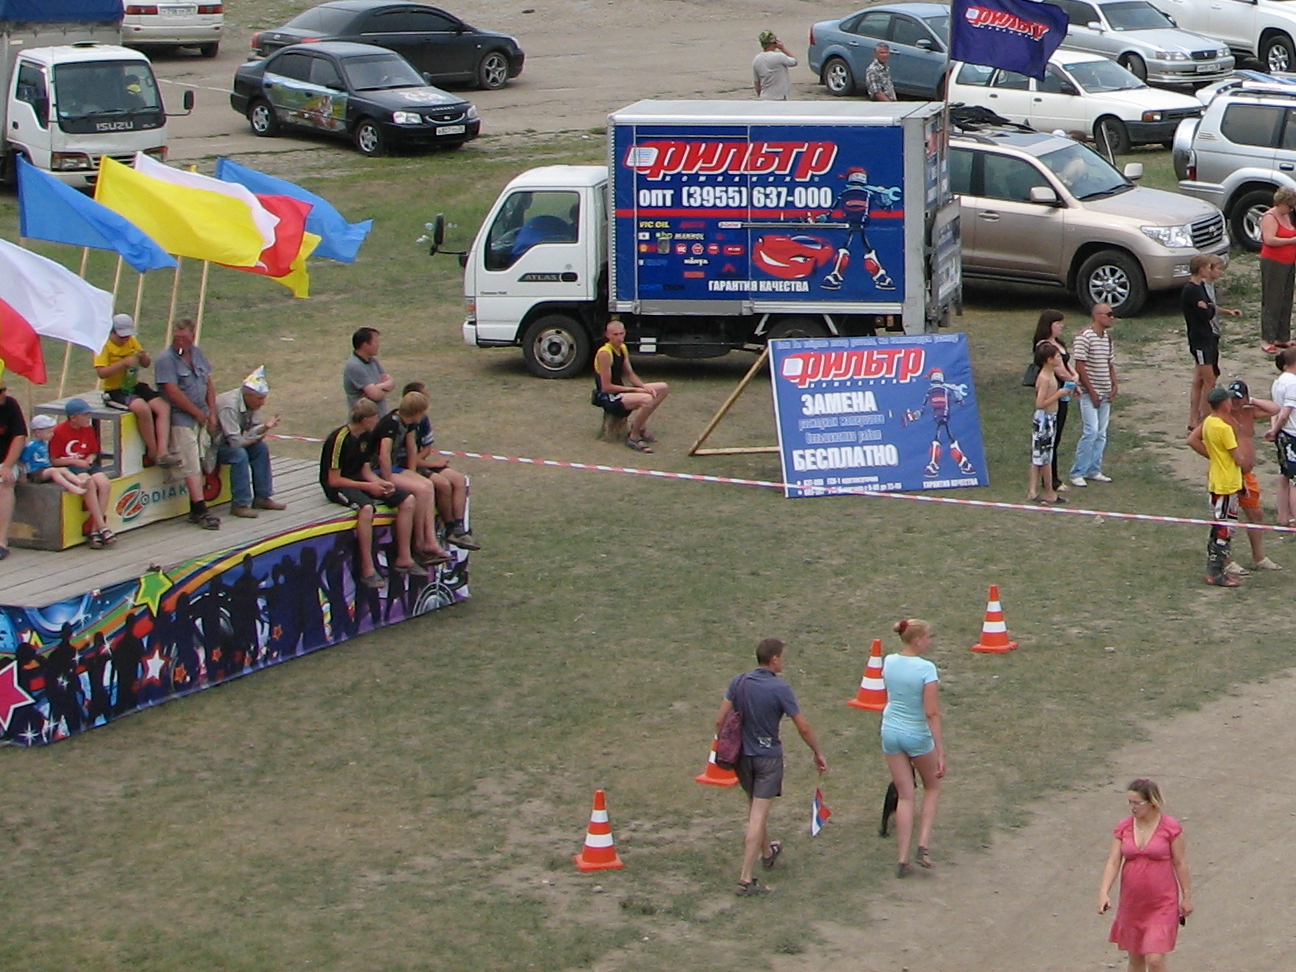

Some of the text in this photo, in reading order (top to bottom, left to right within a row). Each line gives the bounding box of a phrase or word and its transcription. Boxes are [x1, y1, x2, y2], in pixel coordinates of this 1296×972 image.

[96, 121, 134, 131] ISUZU
[682, 186, 748, 207] (3955)
[752, 186, 832, 208] 637-000
[708, 280, 810, 293] ГАРАНТИЯ КАЧЕСТВА
[801, 391, 879, 416] ЗАМЕНА
[792, 444, 900, 472] БЕСПЛАТНО
[114, 482, 187, 524] ZODIAK
